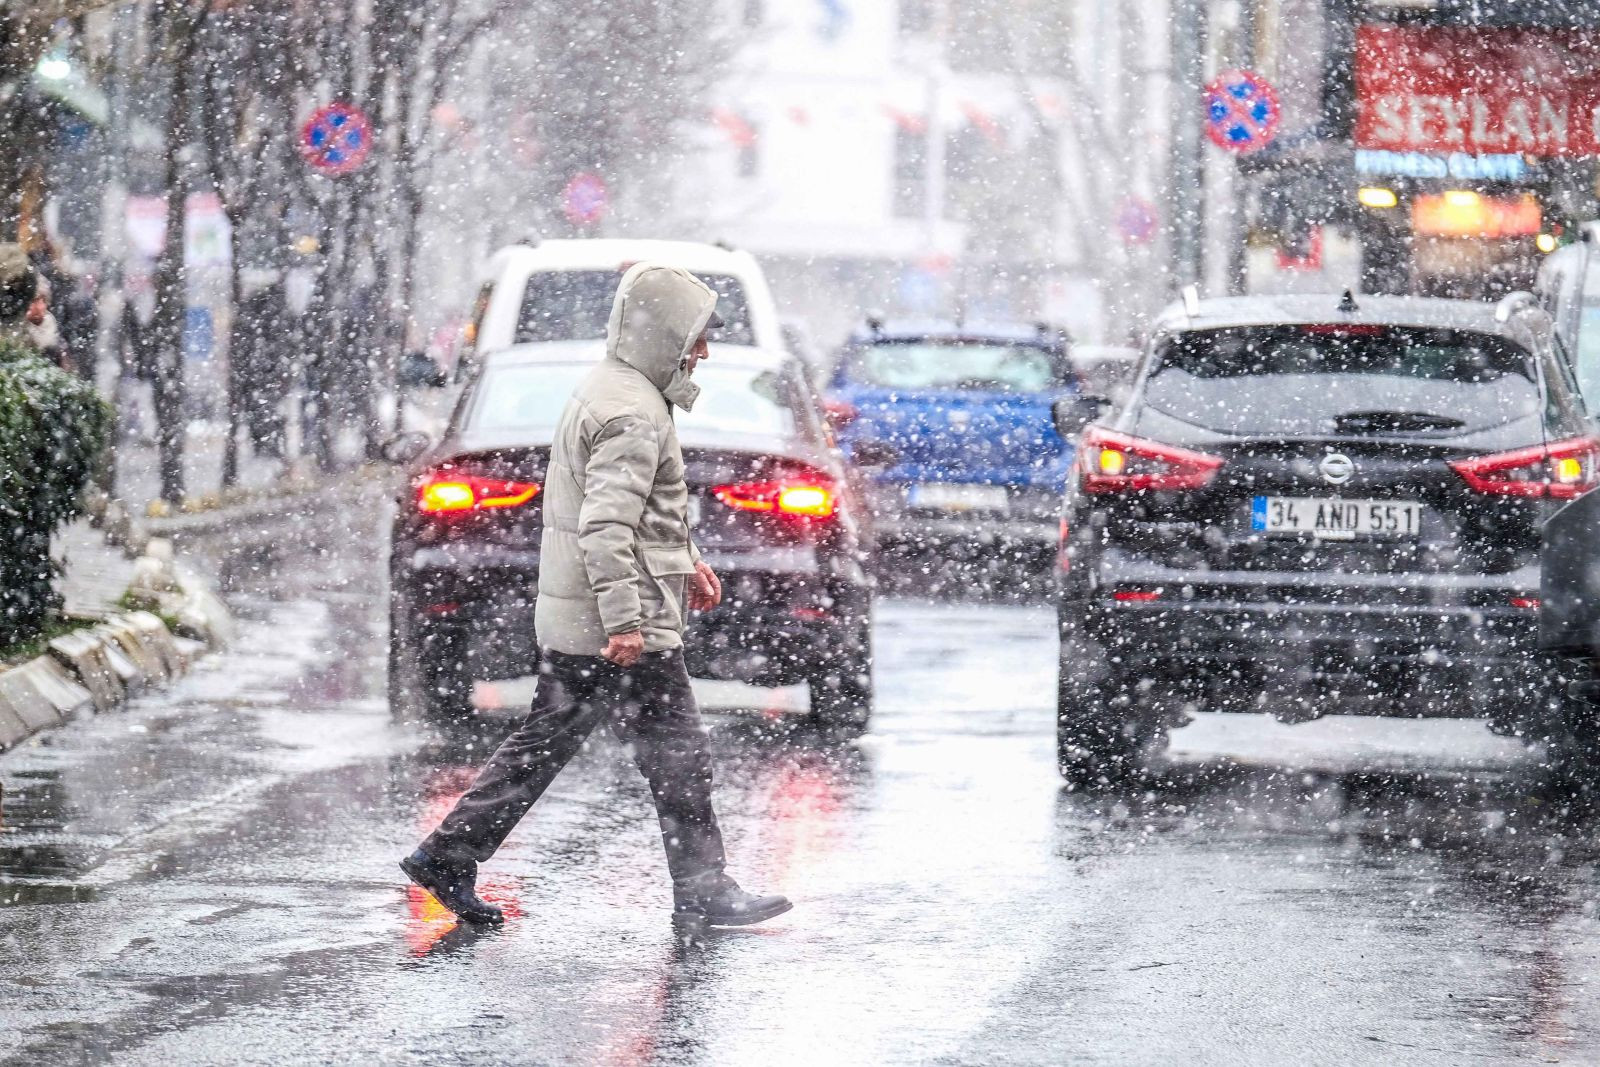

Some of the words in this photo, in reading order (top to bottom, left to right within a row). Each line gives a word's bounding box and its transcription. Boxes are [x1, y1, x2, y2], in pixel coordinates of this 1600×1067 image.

[1271, 502, 1298, 528] 34
[1315, 503, 1359, 531] AND
[1370, 505, 1413, 532] 551
